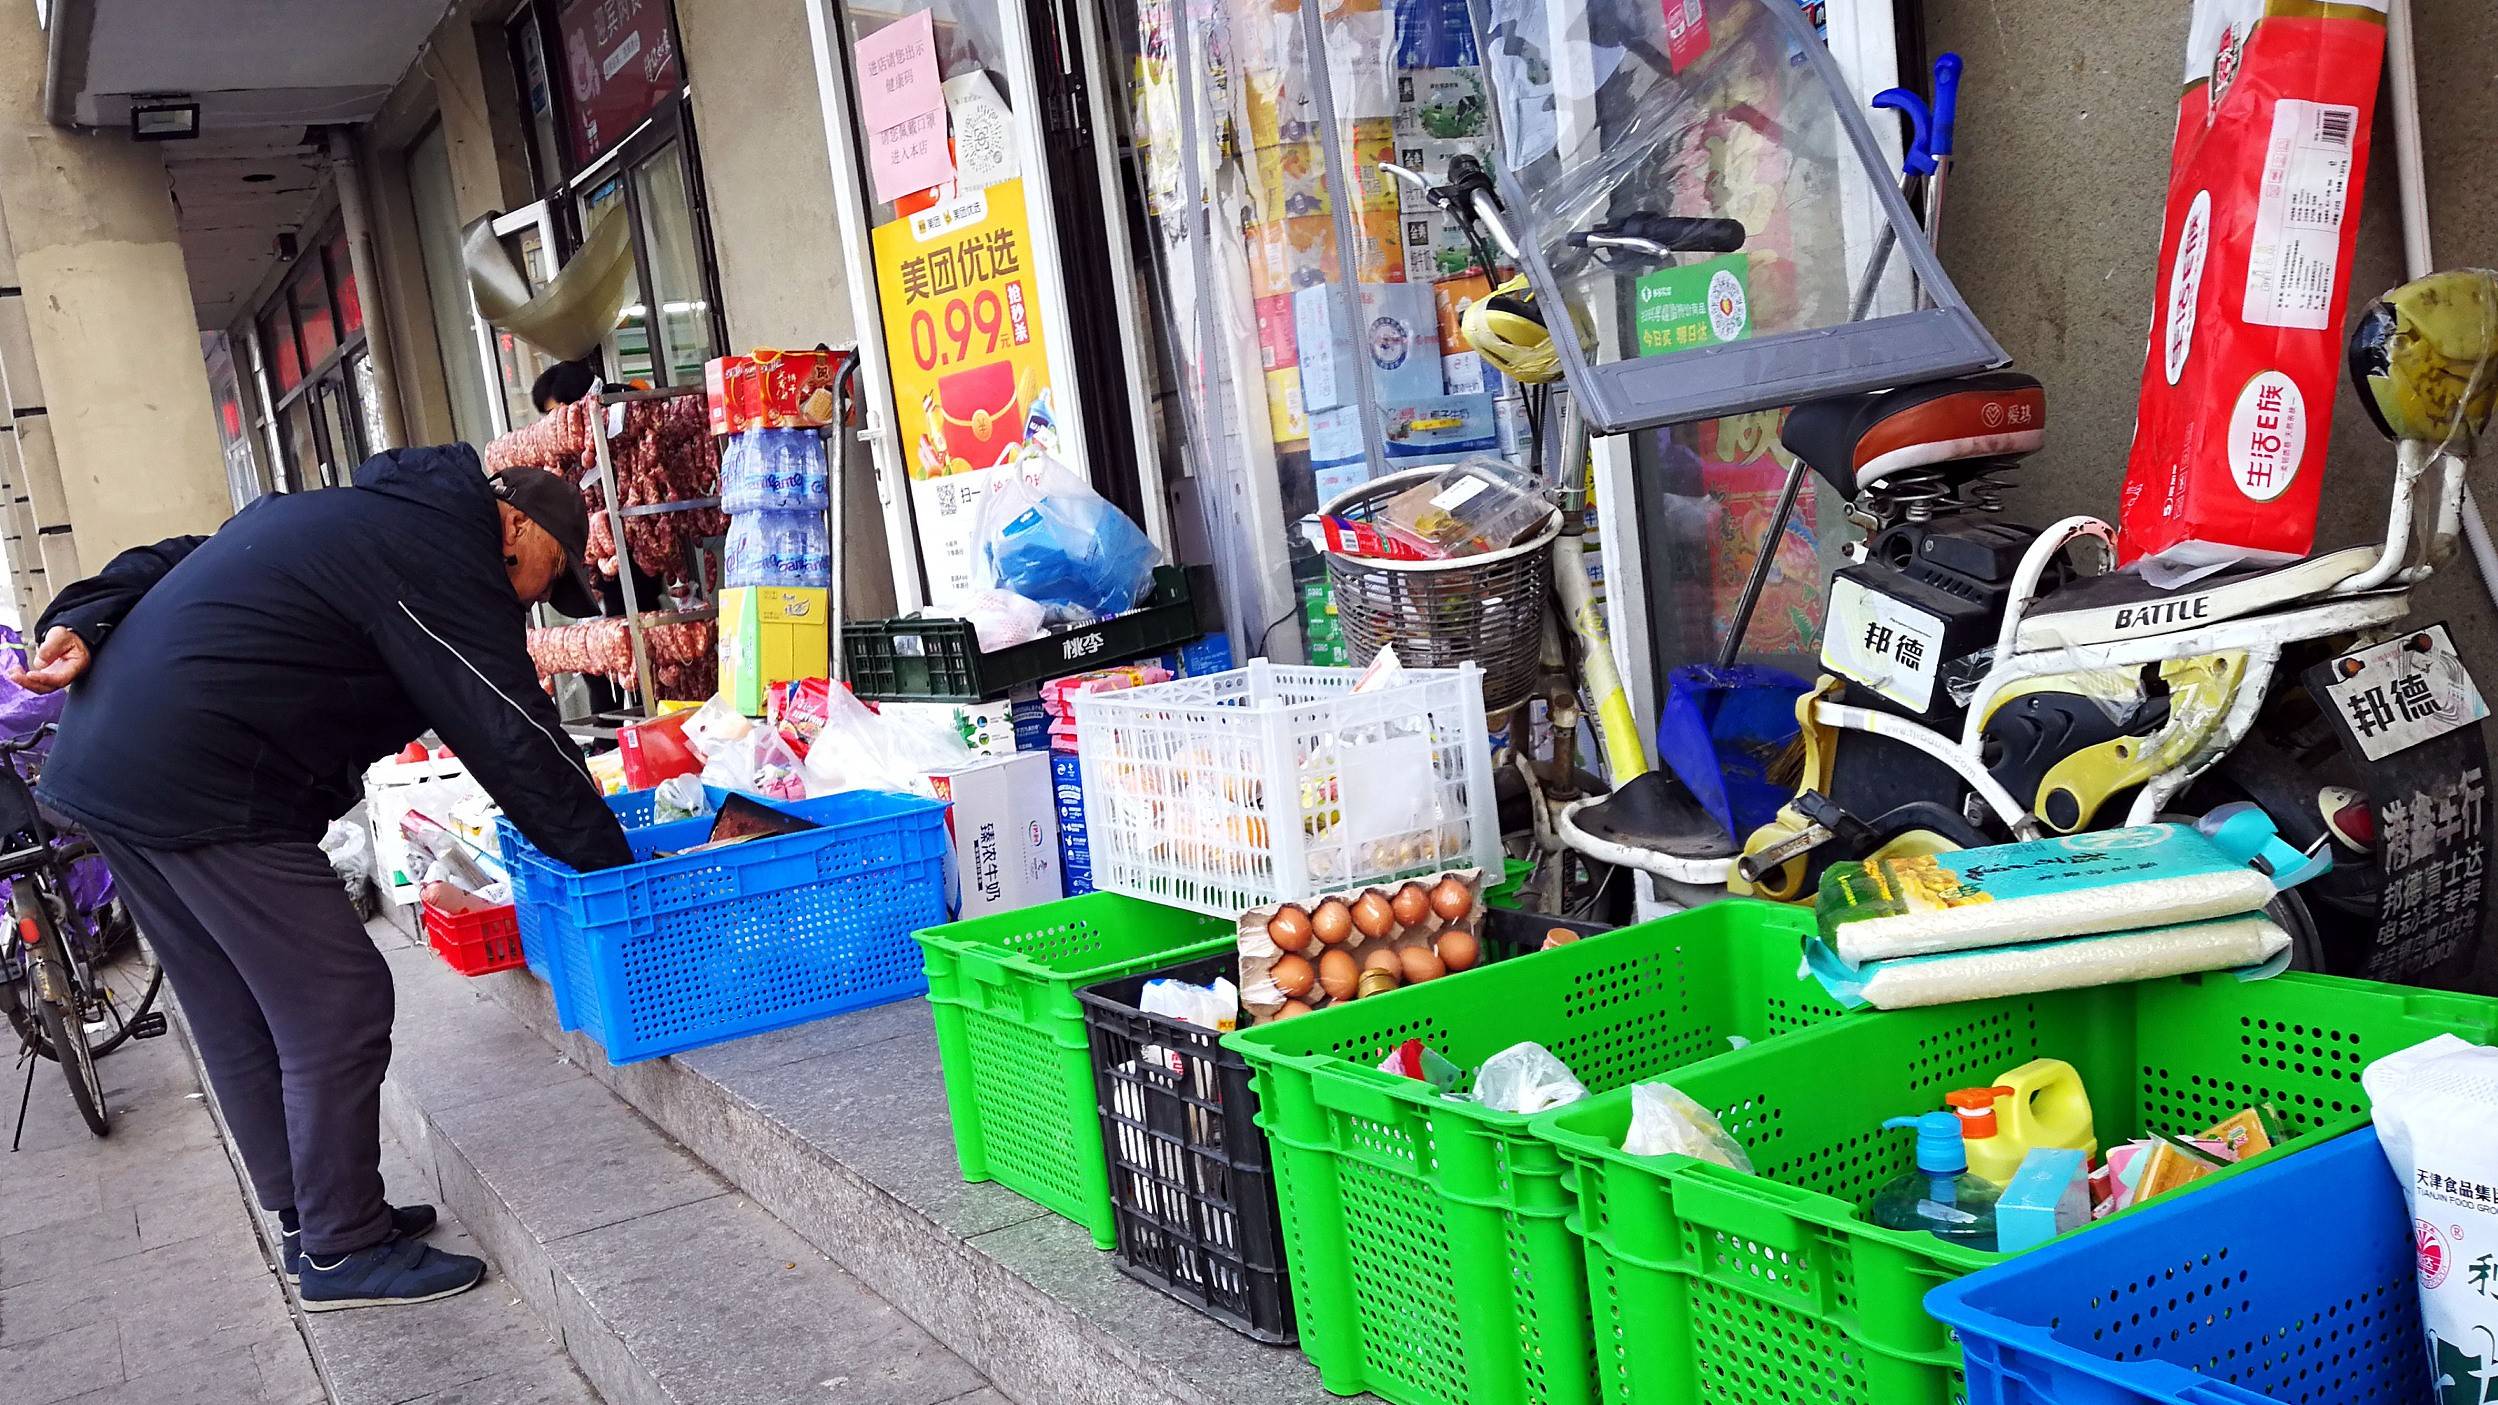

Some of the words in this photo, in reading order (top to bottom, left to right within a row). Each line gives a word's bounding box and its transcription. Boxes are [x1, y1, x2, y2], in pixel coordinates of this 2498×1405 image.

[891, 140, 928, 165] 进入本店
[900, 227, 1020, 305] 美团优选
[910, 289, 1003, 371] 0.99
[2007, 404, 2032, 426] 爱玛
[2247, 384, 2285, 488] 生活E族
[2115, 596, 2209, 630] BATTLE
[1062, 632, 1105, 660] 桃李
[1864, 620, 1925, 672] 邦德
[2347, 673, 2441, 738] 邦德
[2382, 847, 2486, 919] 邦德富士达
[2376, 881, 2481, 945] 电动车专卖
[2416, 1186, 2448, 1203] TIANJIN
[2449, 1195, 2475, 1210] FOOD
[2476, 1203, 2498, 1215] GRO
